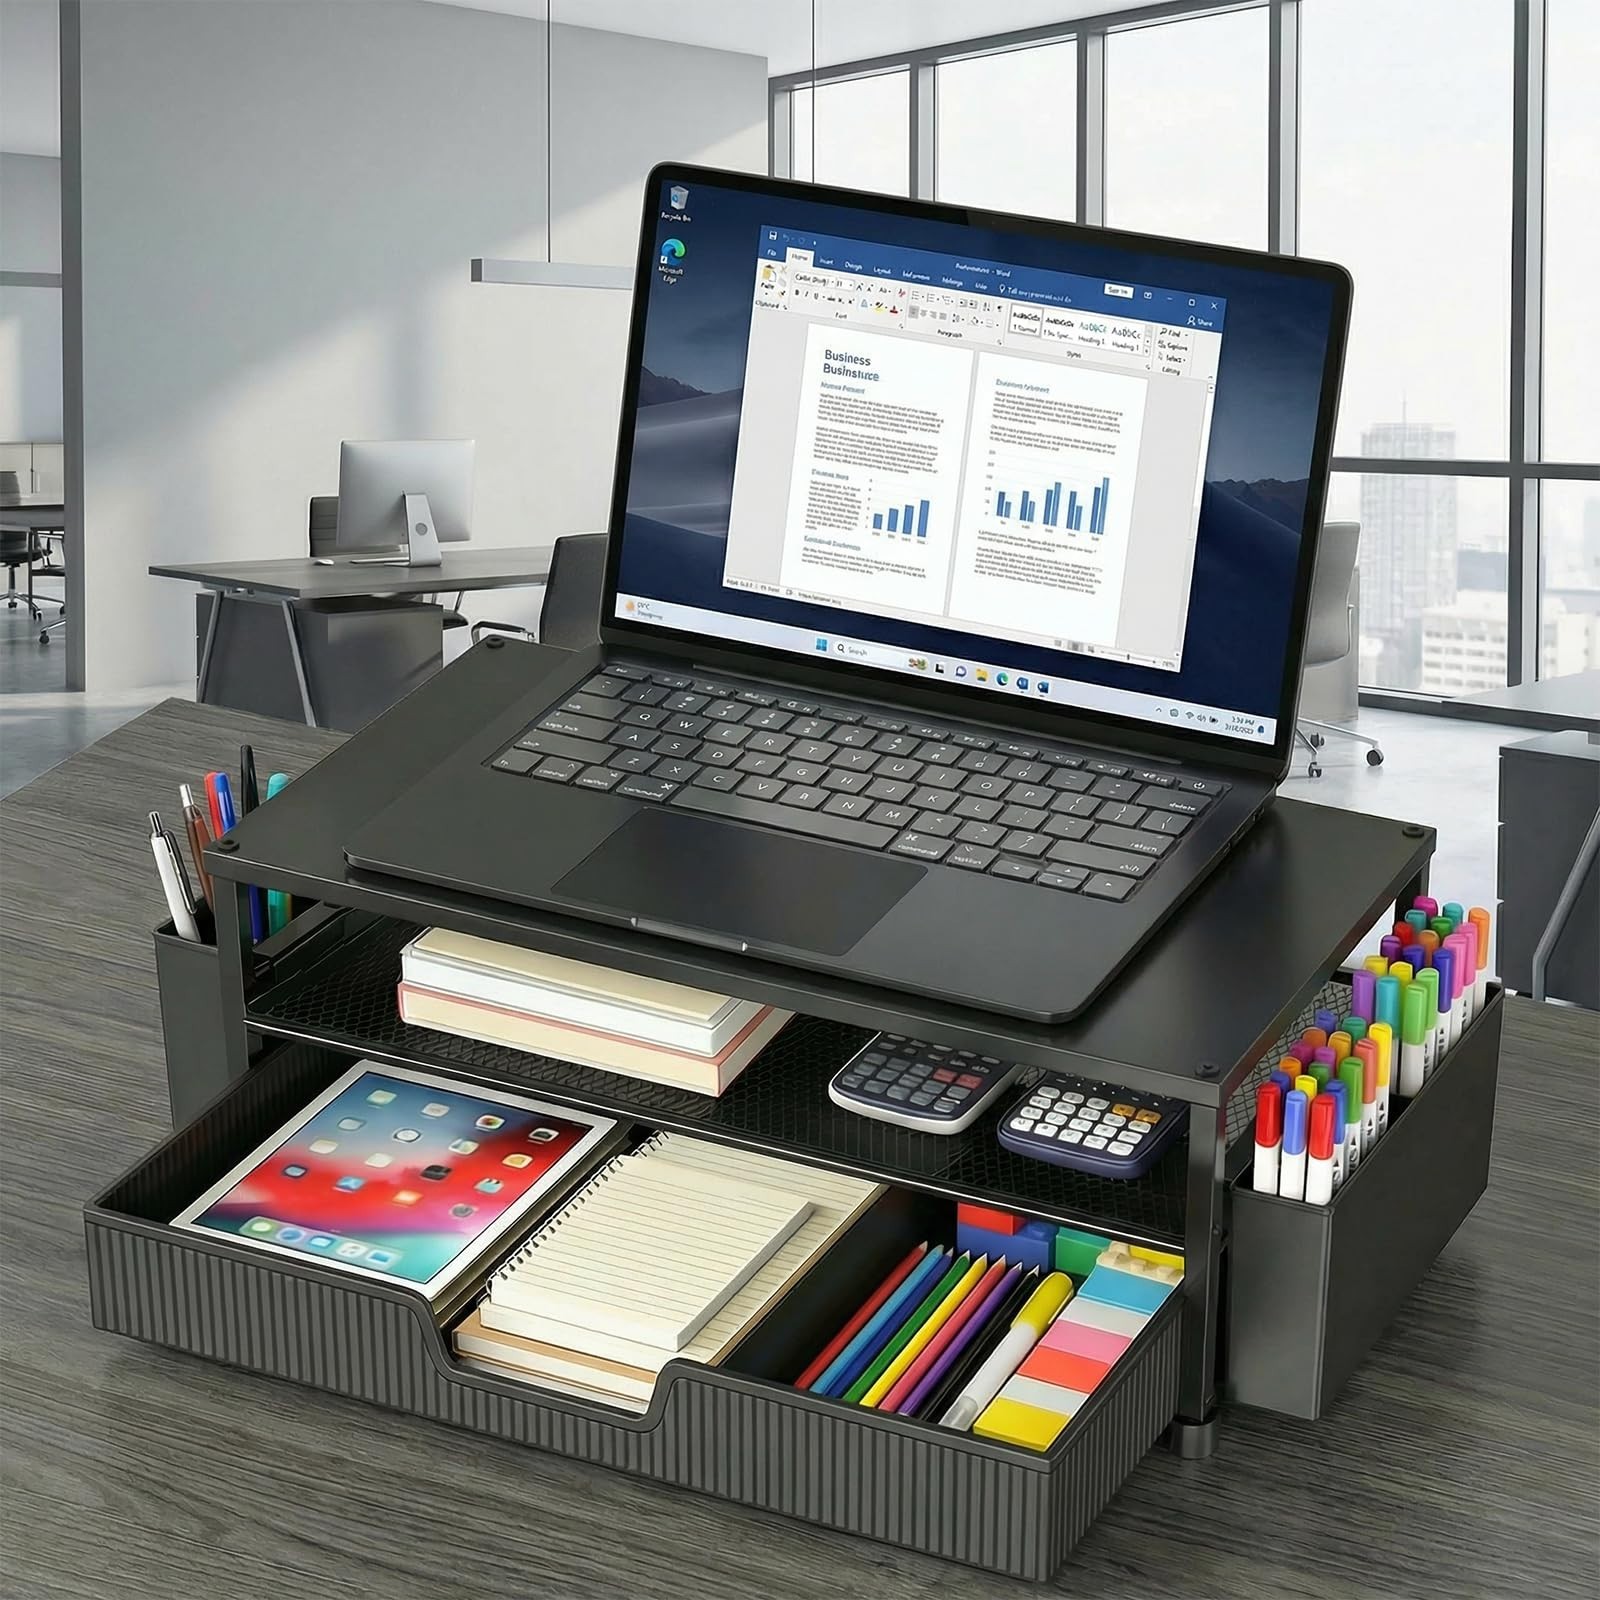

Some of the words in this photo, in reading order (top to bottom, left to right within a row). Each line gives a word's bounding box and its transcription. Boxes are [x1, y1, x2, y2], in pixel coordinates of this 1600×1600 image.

[824, 349, 872, 366] Business
[639, 712, 651, 721] Q
[679, 720, 694, 729] W
[628, 734, 638, 742] A
[722, 730, 732, 738] E
[670, 742, 681, 750] S
[712, 751, 724, 759] D
[669, 766, 682, 774] X
[796, 768, 808, 776] G
[892, 764, 905, 772] U
[712, 774, 726, 783] C
[840, 777, 854, 785] H
[758, 783, 769, 791] V
[928, 794, 938, 803] K
[842, 801, 855, 810] N
[885, 810, 901, 820] M
